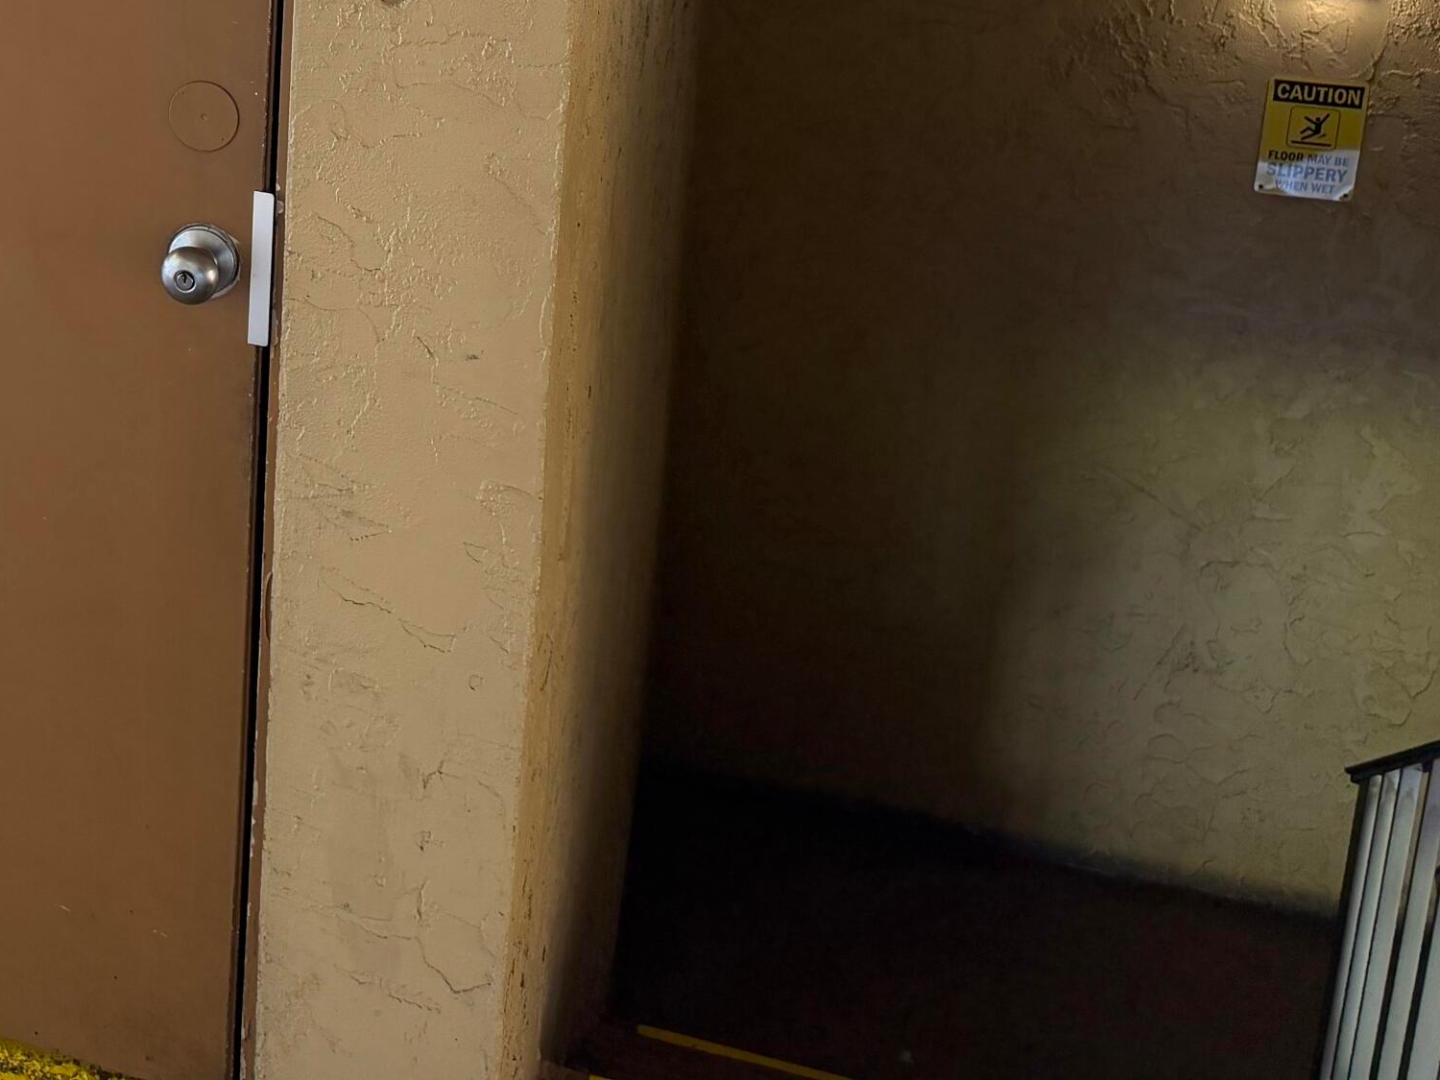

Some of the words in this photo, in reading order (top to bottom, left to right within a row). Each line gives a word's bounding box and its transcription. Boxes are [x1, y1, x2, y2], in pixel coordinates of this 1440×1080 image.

[1277, 82, 1362, 106] CAUTION
[1268, 149, 1304, 161] FLOOR
[1307, 153, 1333, 166] MAY
[1335, 156, 1349, 167] BE
[1266, 161, 1349, 182] SLIPPERY
[1275, 179, 1308, 192] WHEN
[1311, 182, 1336, 194] WET
